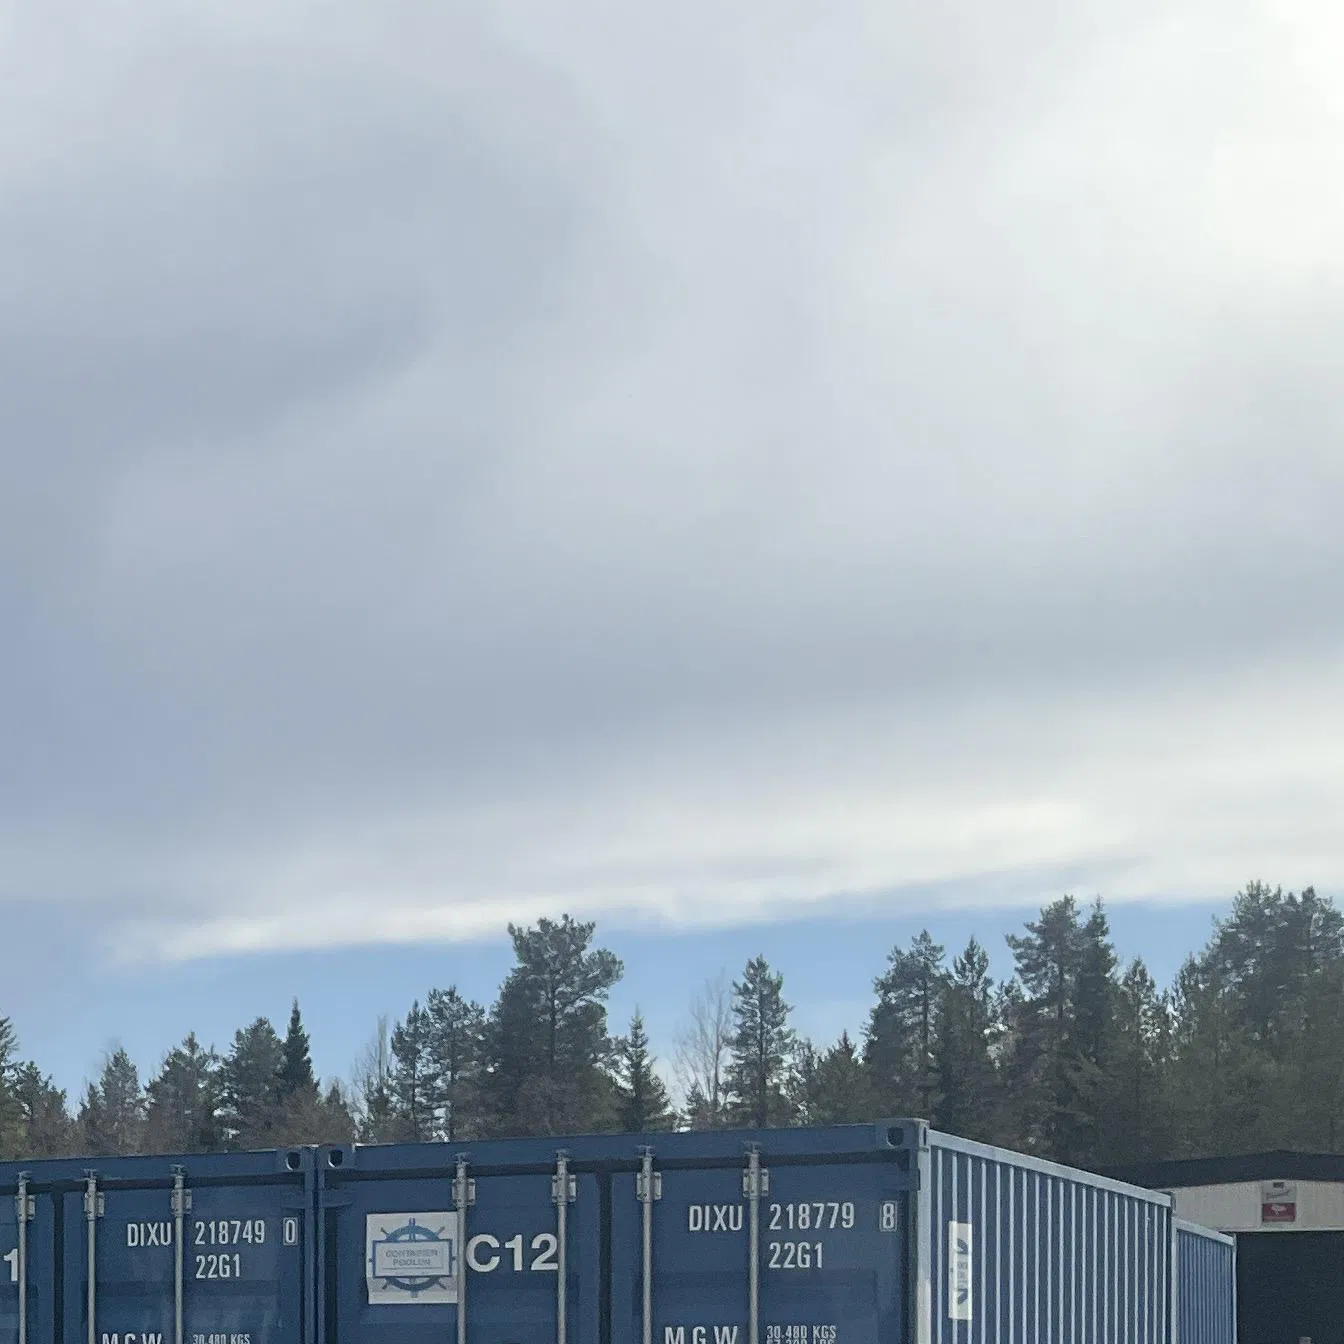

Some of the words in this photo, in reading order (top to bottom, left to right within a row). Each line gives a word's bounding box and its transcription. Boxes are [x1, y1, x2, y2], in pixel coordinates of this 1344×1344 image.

[688, 1205, 743, 1231] DIXU
[769, 1202, 855, 1230] 218779
[880, 1202, 896, 1231] 8
[127, 1223, 172, 1246] DIXU
[194, 1219, 265, 1245] 218749
[466, 1233, 558, 1272] C12
[768, 1241, 823, 1269] 22G1
[195, 1254, 240, 1279] 22G1
[766, 1325, 808, 1339] 30.480
[813, 1325, 837, 1339] KGS
